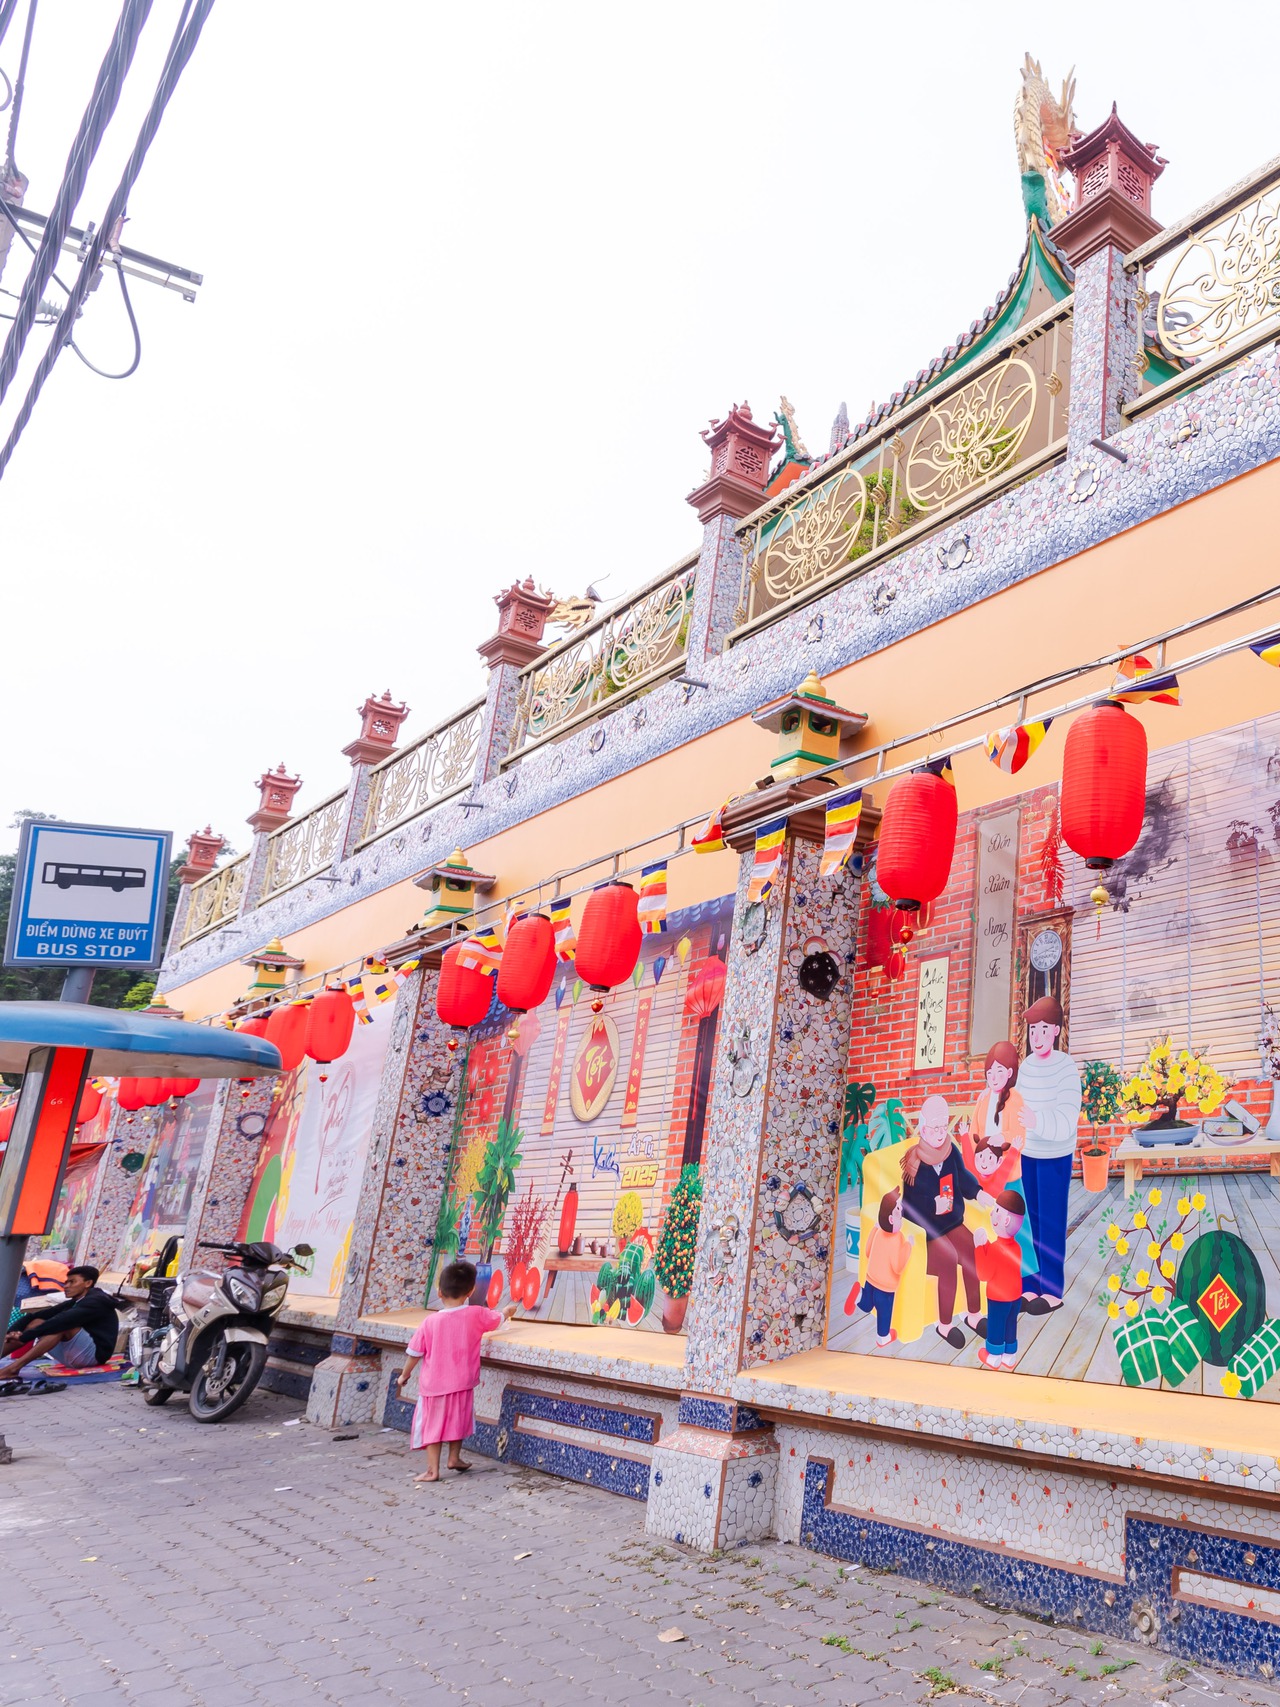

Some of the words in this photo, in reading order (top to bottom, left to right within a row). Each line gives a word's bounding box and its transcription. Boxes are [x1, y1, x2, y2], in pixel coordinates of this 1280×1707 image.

[987, 833, 1011, 853] Đón
[984, 874, 1010, 895] Xuân
[26, 919, 58, 937] ĐIỂM
[62, 923, 96, 939] DỪNG
[99, 927, 115, 940] XE
[118, 926, 149, 941] BUÝT
[983, 917, 1008, 947] Sung
[36, 942, 78, 956] BUS
[84, 944, 136, 958] STOP
[621, 1164, 659, 1189] 2025
[1209, 1288, 1230, 1316] Tết
